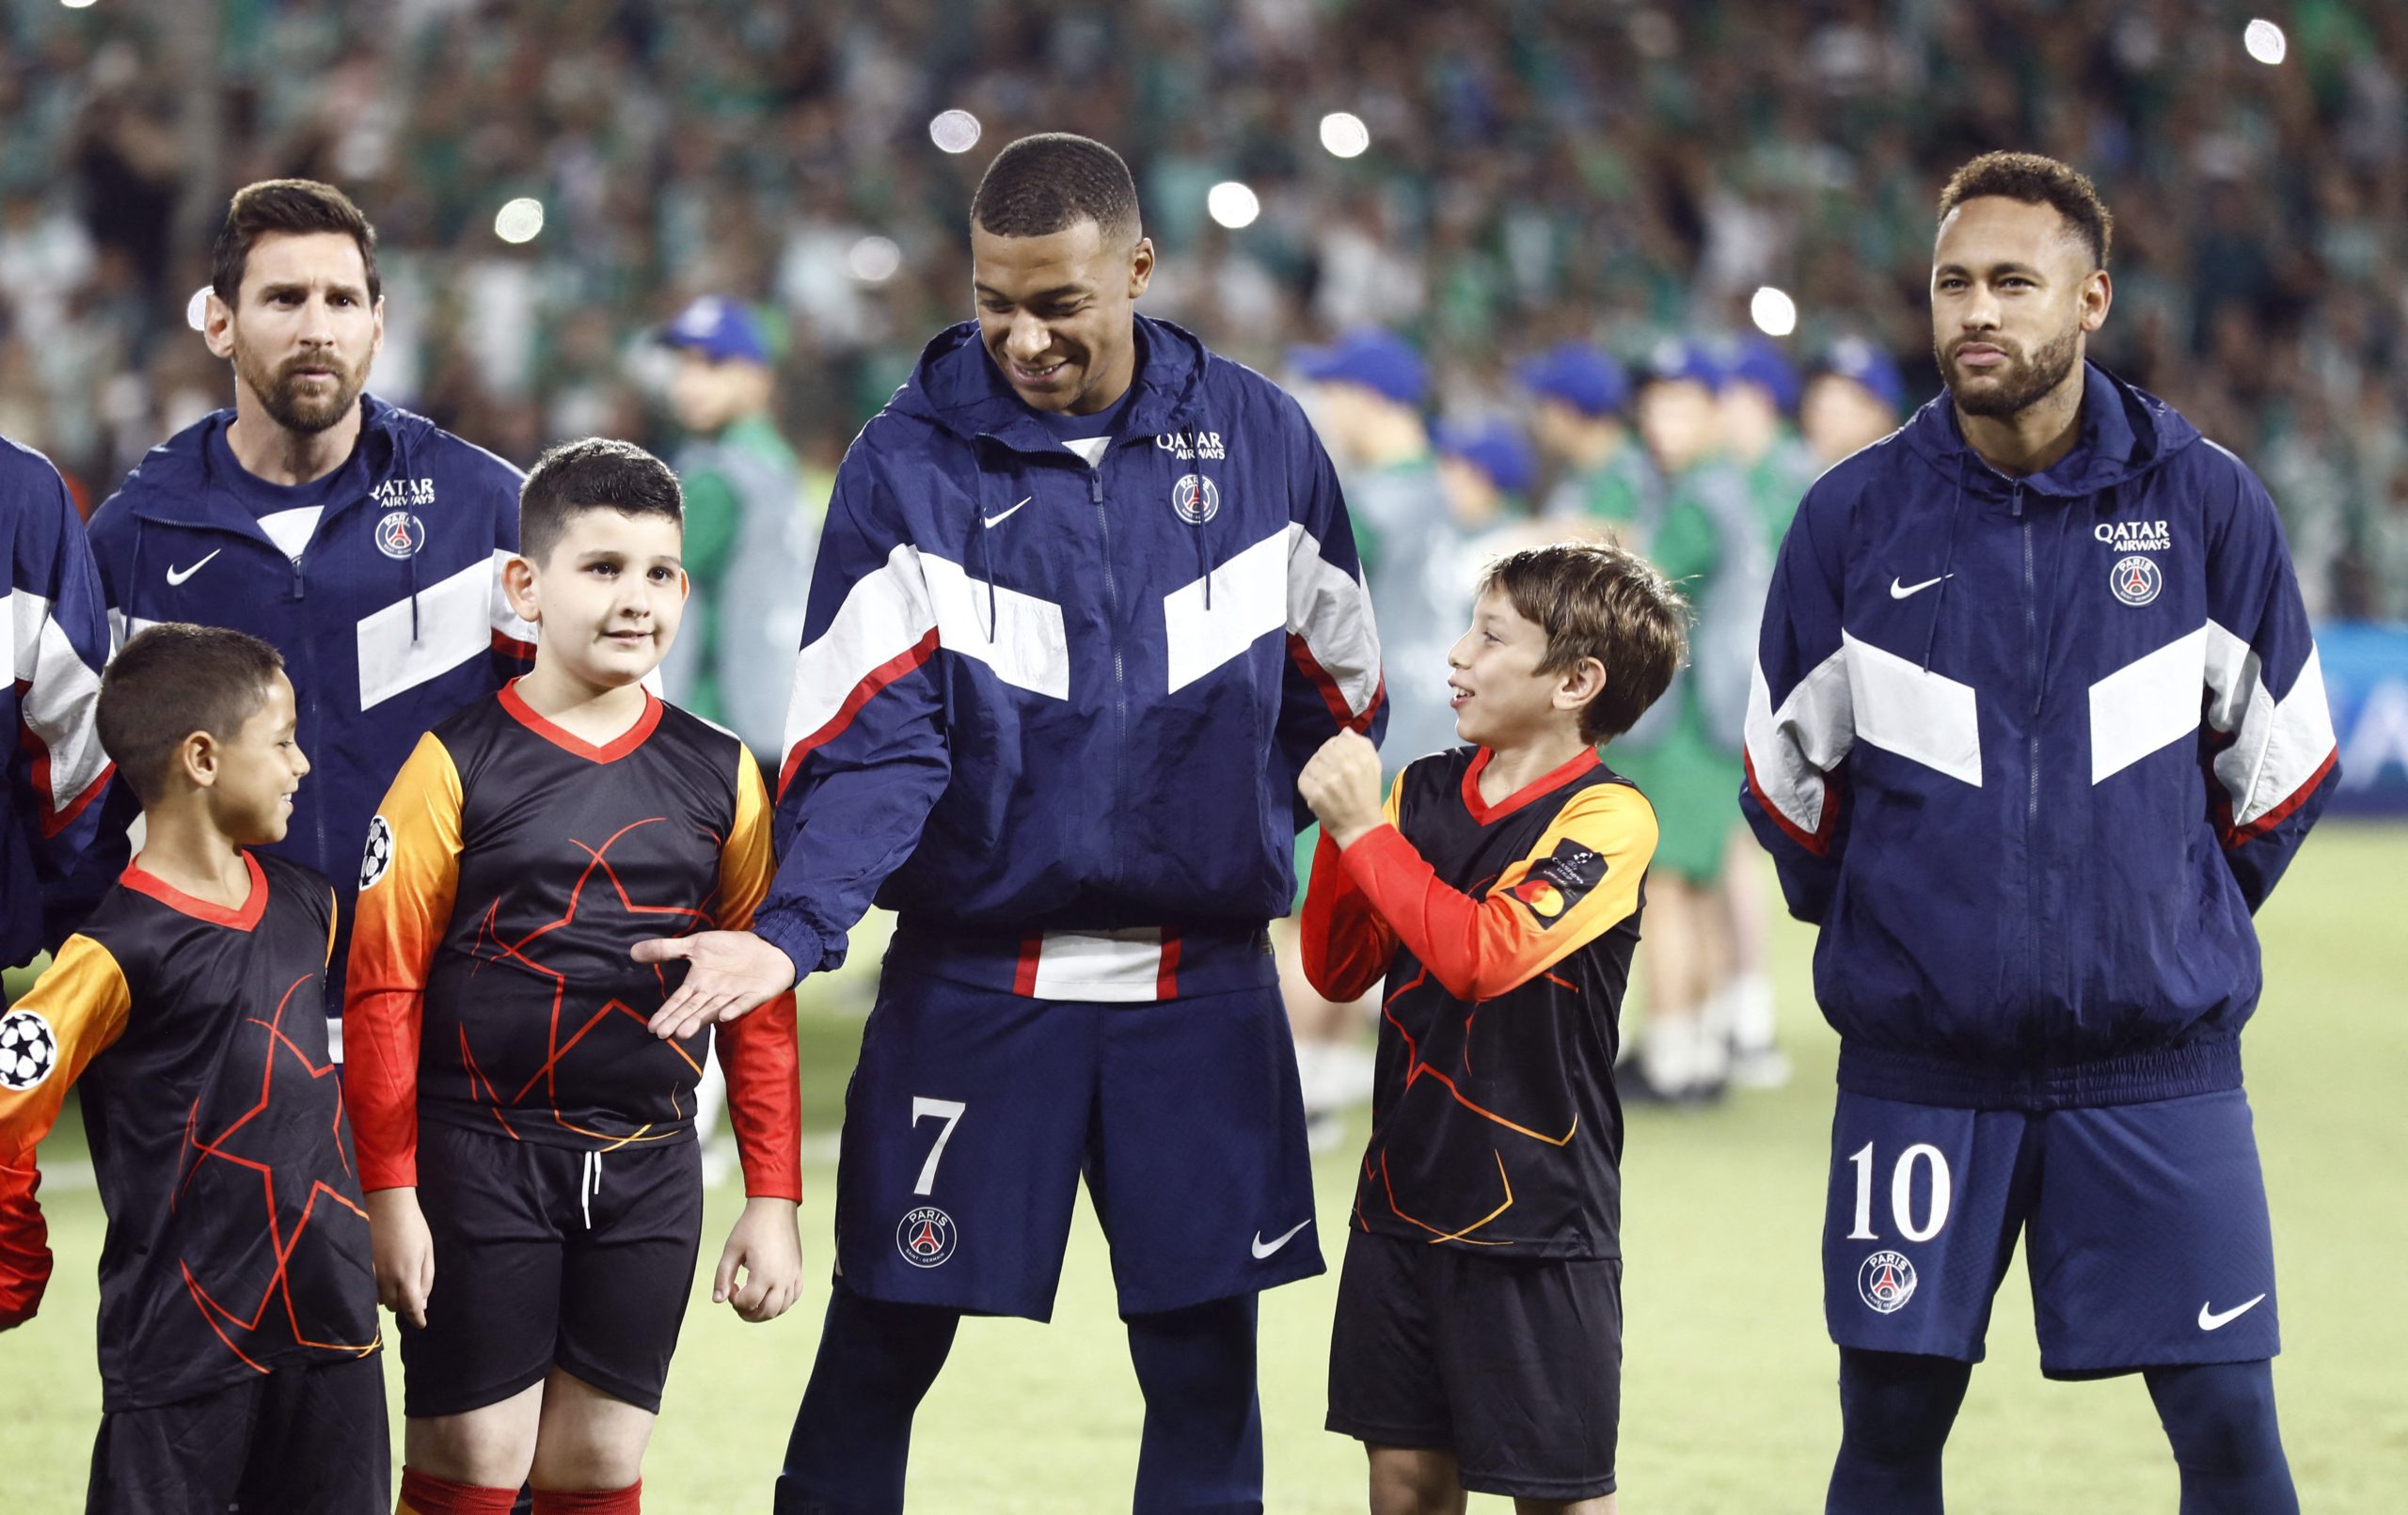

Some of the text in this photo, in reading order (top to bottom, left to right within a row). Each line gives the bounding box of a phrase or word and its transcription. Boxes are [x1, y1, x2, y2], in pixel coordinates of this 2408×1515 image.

[2094, 520, 2170, 544] QATAR
[2113, 537, 2171, 552] AIRWAYS
[2118, 558, 2153, 572] PARIS
[912, 1096, 966, 1196] 7
[1846, 1141, 1951, 1242] 10
[909, 1209, 948, 1227] PARIS
[1869, 1254, 1908, 1271] PARIS
